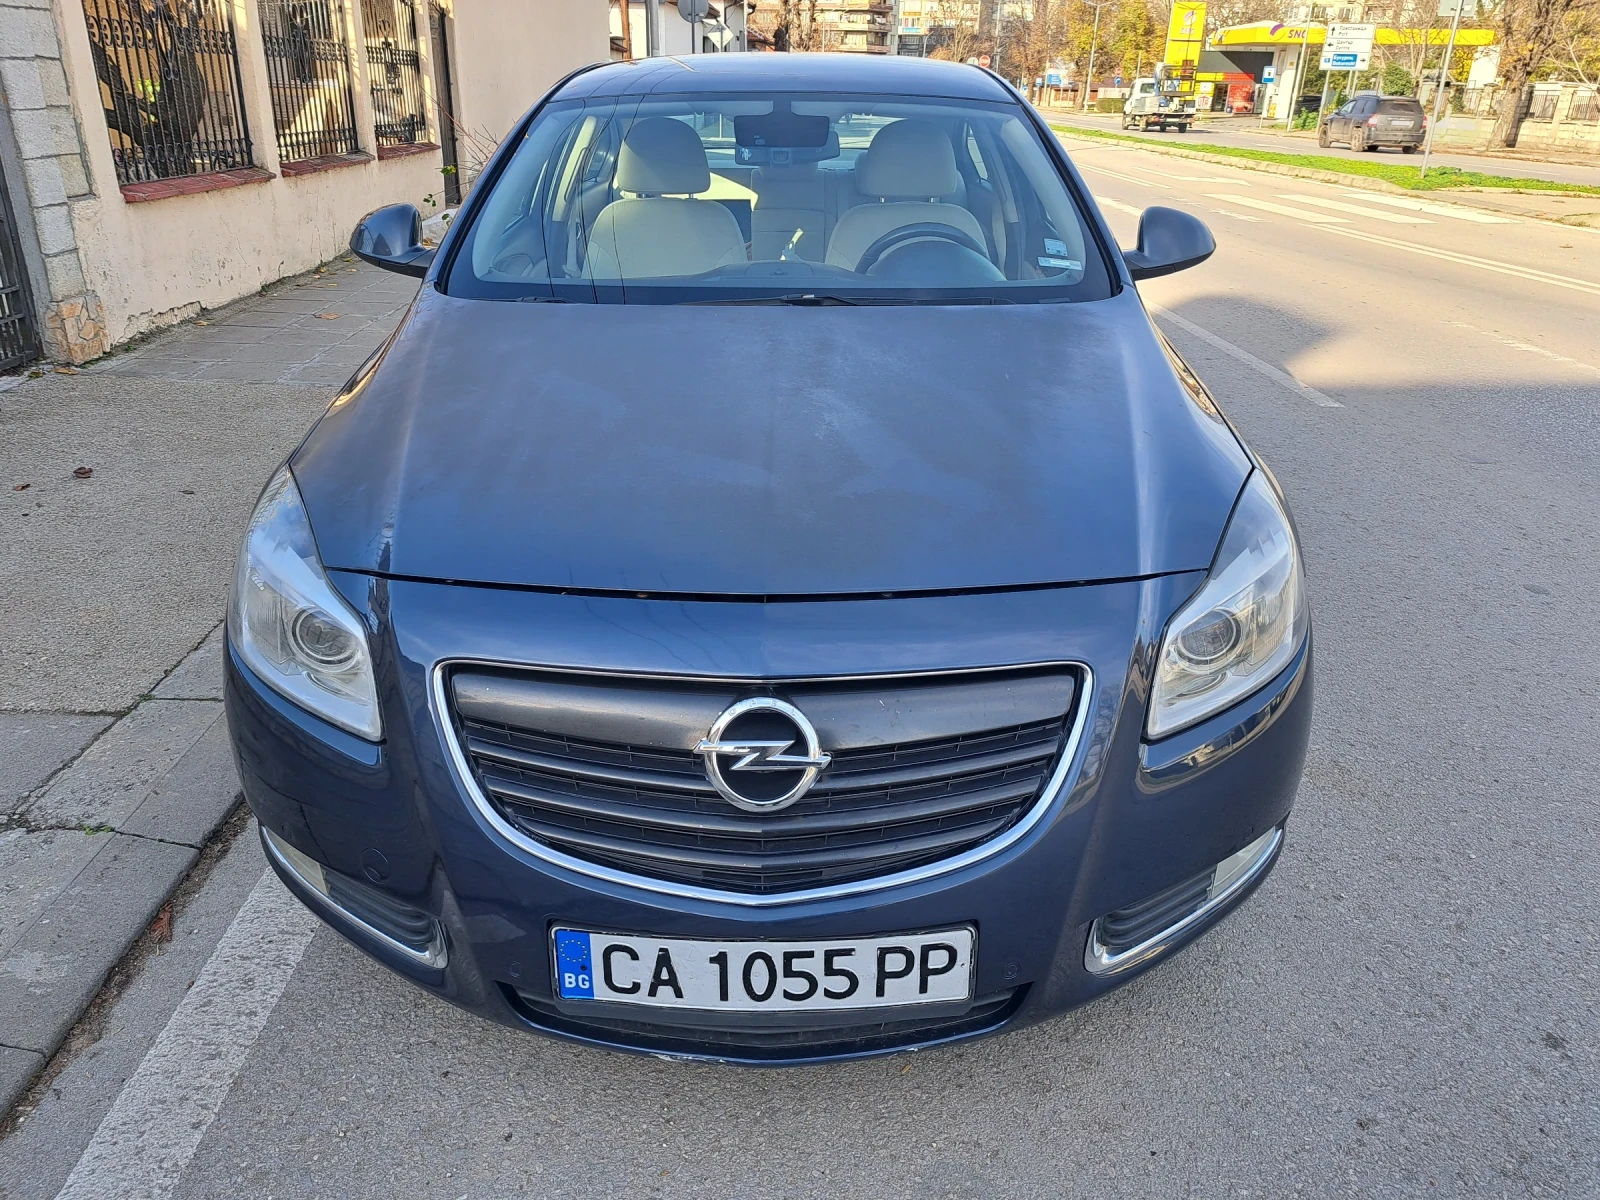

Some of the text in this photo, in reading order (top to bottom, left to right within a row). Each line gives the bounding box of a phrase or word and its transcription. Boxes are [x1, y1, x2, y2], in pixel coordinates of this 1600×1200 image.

[727, 699, 797, 717] OPEL
[564, 972, 590, 989] BG
[602, 942, 958, 1002] CA 1055 PP
